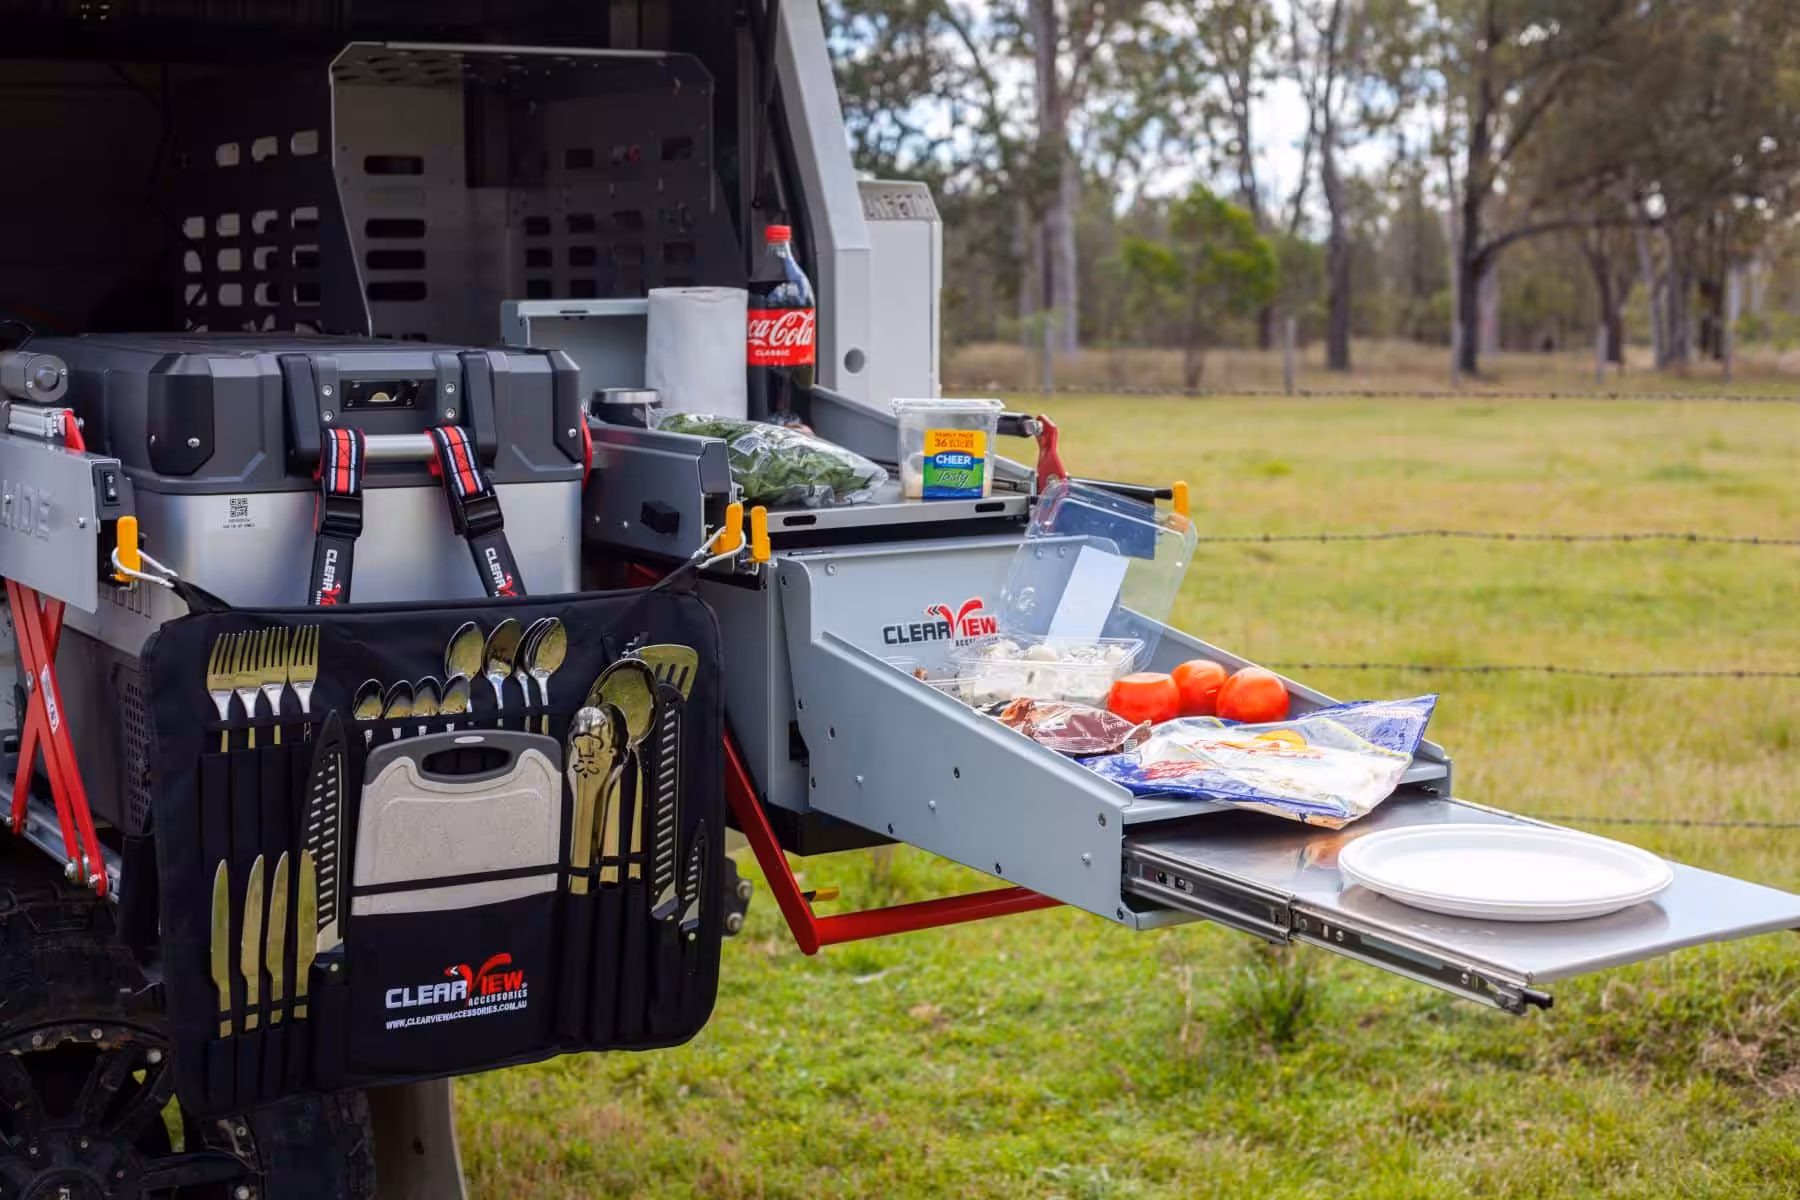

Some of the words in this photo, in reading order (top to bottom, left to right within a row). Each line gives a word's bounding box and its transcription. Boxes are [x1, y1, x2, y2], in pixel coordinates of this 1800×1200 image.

[748, 311, 813, 346] ca-Cola
[754, 349, 790, 357] CLASSIC
[934, 438, 948, 448] 36
[935, 454, 972, 465] CHEER
[468, 988, 528, 1007] ACCESSORIES
[385, 1000, 528, 1030] WWW.CLEARVIEWACCESSORIES.COM.AU
